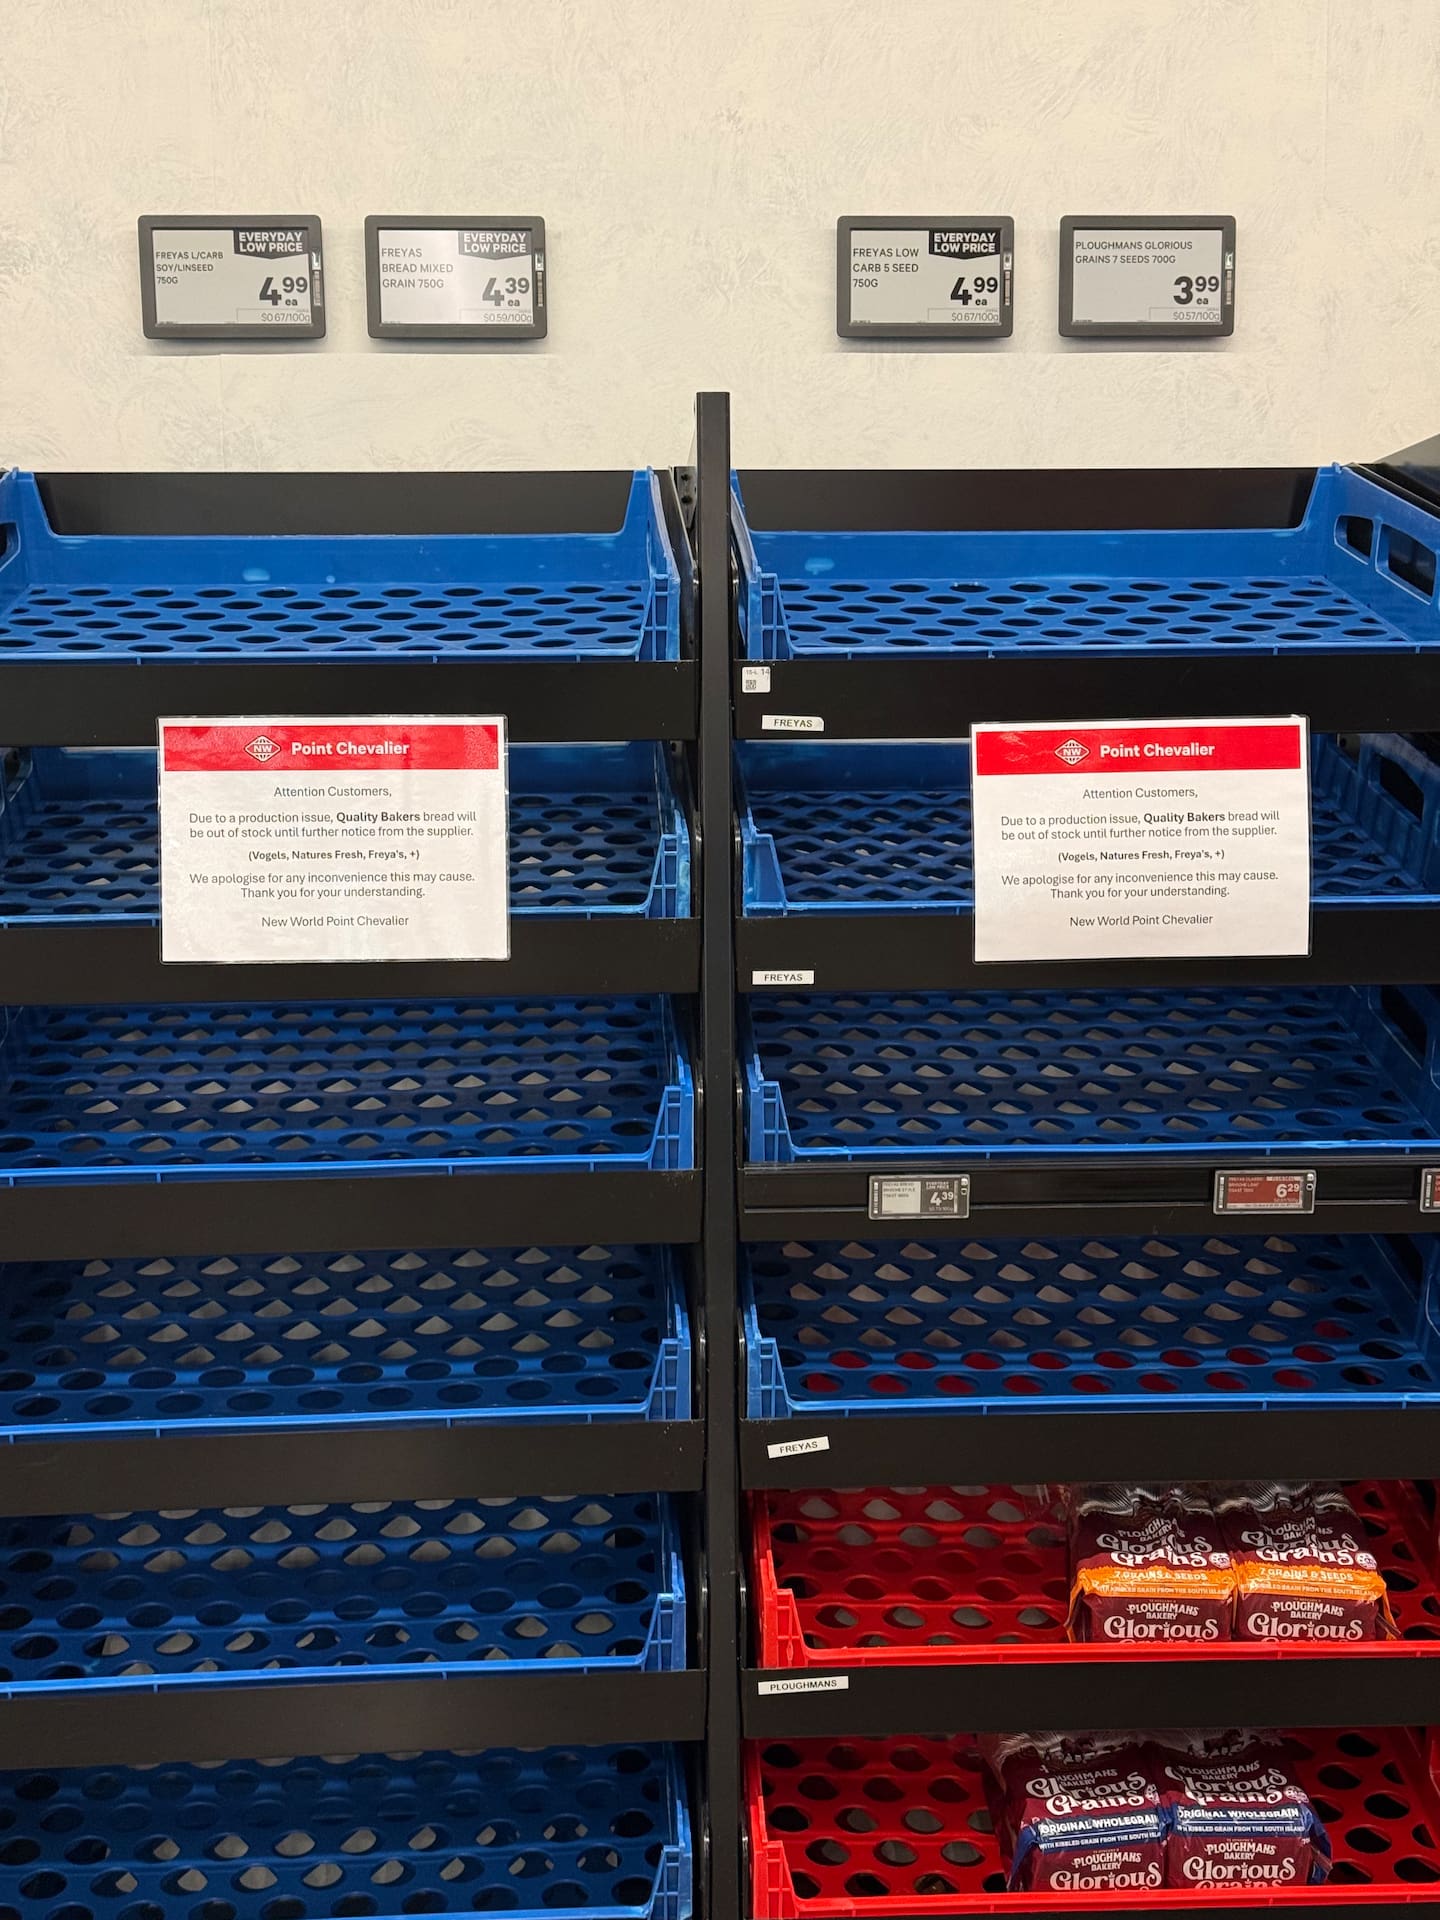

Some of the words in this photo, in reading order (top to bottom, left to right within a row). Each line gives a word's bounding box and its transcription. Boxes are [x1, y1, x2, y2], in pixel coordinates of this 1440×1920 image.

[239, 232, 303, 242] EVERYDAY
[464, 233, 526, 243] EVERYDAY
[934, 233, 996, 243] EVERYDAY
[240, 242, 268, 252] LOW
[269, 242, 303, 252] PRICE
[464, 243, 494, 253] LOW
[495, 243, 526, 253] PRICE
[934, 243, 963, 253] LOW
[964, 243, 995, 253] PRICE
[1075, 241, 1143, 250] PLOUGHMANS
[1144, 241, 1193, 250] GLORIOUS
[191, 252, 223, 260] L/CARB
[381, 248, 422, 258] FREYAS
[853, 248, 893, 257] FREYAS
[896, 248, 919, 257] LOW
[1075, 255, 1111, 264] GRAINS
[1112, 255, 1118, 264] 7
[1119, 255, 1150, 264] SEEDS
[1152, 255, 1176, 264] 700G
[156, 264, 213, 272] SOY/LINSEED
[382, 264, 417, 273] BREAD
[420, 264, 453, 273] MIXED
[853, 264, 881, 273] CARB
[884, 264, 890, 273] 5
[892, 264, 919, 273] SEED
[382, 279, 416, 288] GRAIN
[419, 279, 444, 288] 750G
[853, 279, 878, 288] 750G
[507, 299, 520, 307] ea
[774, 718, 813, 728] FREYAS
[252, 742, 274, 753] NW
[291, 741, 333, 755] Point
[336, 740, 410, 756] Chevalier
[1062, 745, 1083, 757] NW
[1100, 743, 1140, 758] Point
[1143, 742, 1215, 757] Chevalier
[273, 786, 325, 797] Attention
[327, 786, 392, 797] Customers,
[1082, 788, 1133, 799] Attention
[1135, 787, 1198, 798] Customers,
[189, 813, 212, 823] Due
[215, 814, 226, 823] to
[229, 815, 236, 823] a
[238, 812, 299, 825] production
[301, 811, 333, 824] issue,
[336, 811, 378, 824] Quality
[380, 811, 421, 822] Bakers
[423, 811, 454, 821] bread
[456, 811, 476, 821] will
[1001, 815, 1023, 826] Due
[1025, 816, 1037, 826] to
[1039, 817, 1045, 825] a
[1048, 814, 1107, 827] production
[1109, 813, 1141, 824] issue,
[1143, 812, 1185, 825] Quality
[1187, 811, 1226, 822] Bakers
[1228, 811, 1258, 821] bread
[1260, 810, 1280, 821] will
[189, 827, 204, 838] be
[206, 828, 225, 838] out
[227, 827, 239, 838] of
[241, 827, 272, 838] stock
[274, 826, 299, 837] until
[301, 826, 339, 837] further
[341, 825, 376, 837] notice
[378, 826, 404, 837] from
[406, 826, 424, 836] the
[426, 825, 473, 838] supplier.
[1001, 830, 1015, 840] be
[1017, 830, 1036, 840] out
[1037, 829, 1049, 840] of
[1051, 828, 1081, 839] stock
[1083, 828, 1107, 839] until
[1109, 827, 1146, 838] further
[1148, 826, 1182, 837] notice
[1184, 826, 1210, 837] from
[1212, 825, 1229, 836] the
[1231, 824, 1277, 838] supplier.
[248, 850, 289, 862] (Vogels,
[291, 850, 333, 859] Natures
[334, 849, 366, 860] Fresh,
[368, 849, 407, 861] Freya's,
[409, 849, 420, 861] +)
[1058, 851, 1098, 863] (Vogels,
[1100, 851, 1140, 860] Natures
[1141, 850, 1172, 860] Fresh,
[1174, 849, 1212, 860] Freya's,
[1214, 849, 1225, 860] +)
[189, 873, 209, 884] We
[211, 872, 266, 886] apologise
[267, 872, 283, 883] for
[285, 874, 306, 885] any
[307, 871, 388, 883] inconvenience
[390, 871, 411, 882] this
[412, 873, 437, 884] may
[438, 873, 475, 882] cause.
[240, 887, 275, 898] Thank
[276, 889, 297, 900] you
[299, 887, 315, 897] for
[316, 888, 342, 900] your
[343, 885, 425, 899] understanding.
[261, 916, 288, 927] New
[289, 916, 324, 927] World
[326, 915, 354, 926] Point
[356, 915, 409, 926] Chevalier
[1069, 916, 1095, 927] New
[1097, 915, 1130, 926] World
[1132, 914, 1159, 925] Point
[1161, 914, 1213, 925] Chevalier
[764, 973, 803, 982] FREYAS
[780, 1441, 818, 1453] FREYAS
[1268, 1568, 1308, 1579] GRAINS
[1320, 1572, 1354, 1581] SEEDS
[1127, 1603, 1200, 1616] PLOUGHMANS
[1271, 1601, 1345, 1617] PLOUGHMANS
[1145, 1612, 1177, 1620] BAKERY
[1290, 1611, 1323, 1620] BAKERY
[1103, 1615, 1219, 1640] Glorious
[1247, 1612, 1364, 1641] Glorious
[770, 1680, 837, 1691] PLOUGHMANS
[1178, 1809, 1226, 1819] ORIGINAL
[1227, 1808, 1299, 1818] WHOLEGRAIN
[1039, 1820, 1092, 1835] ORIGINAL
[1204, 1842, 1277, 1856] PLOUGHMANS
[1072, 1851, 1142, 1869] PLOUGHMANS
[1223, 1852, 1256, 1861] BAKERY
[1090, 1861, 1122, 1872] BAKERY
[1182, 1856, 1296, 1881] Glorious
[1050, 1861, 1163, 1891] Glorious
